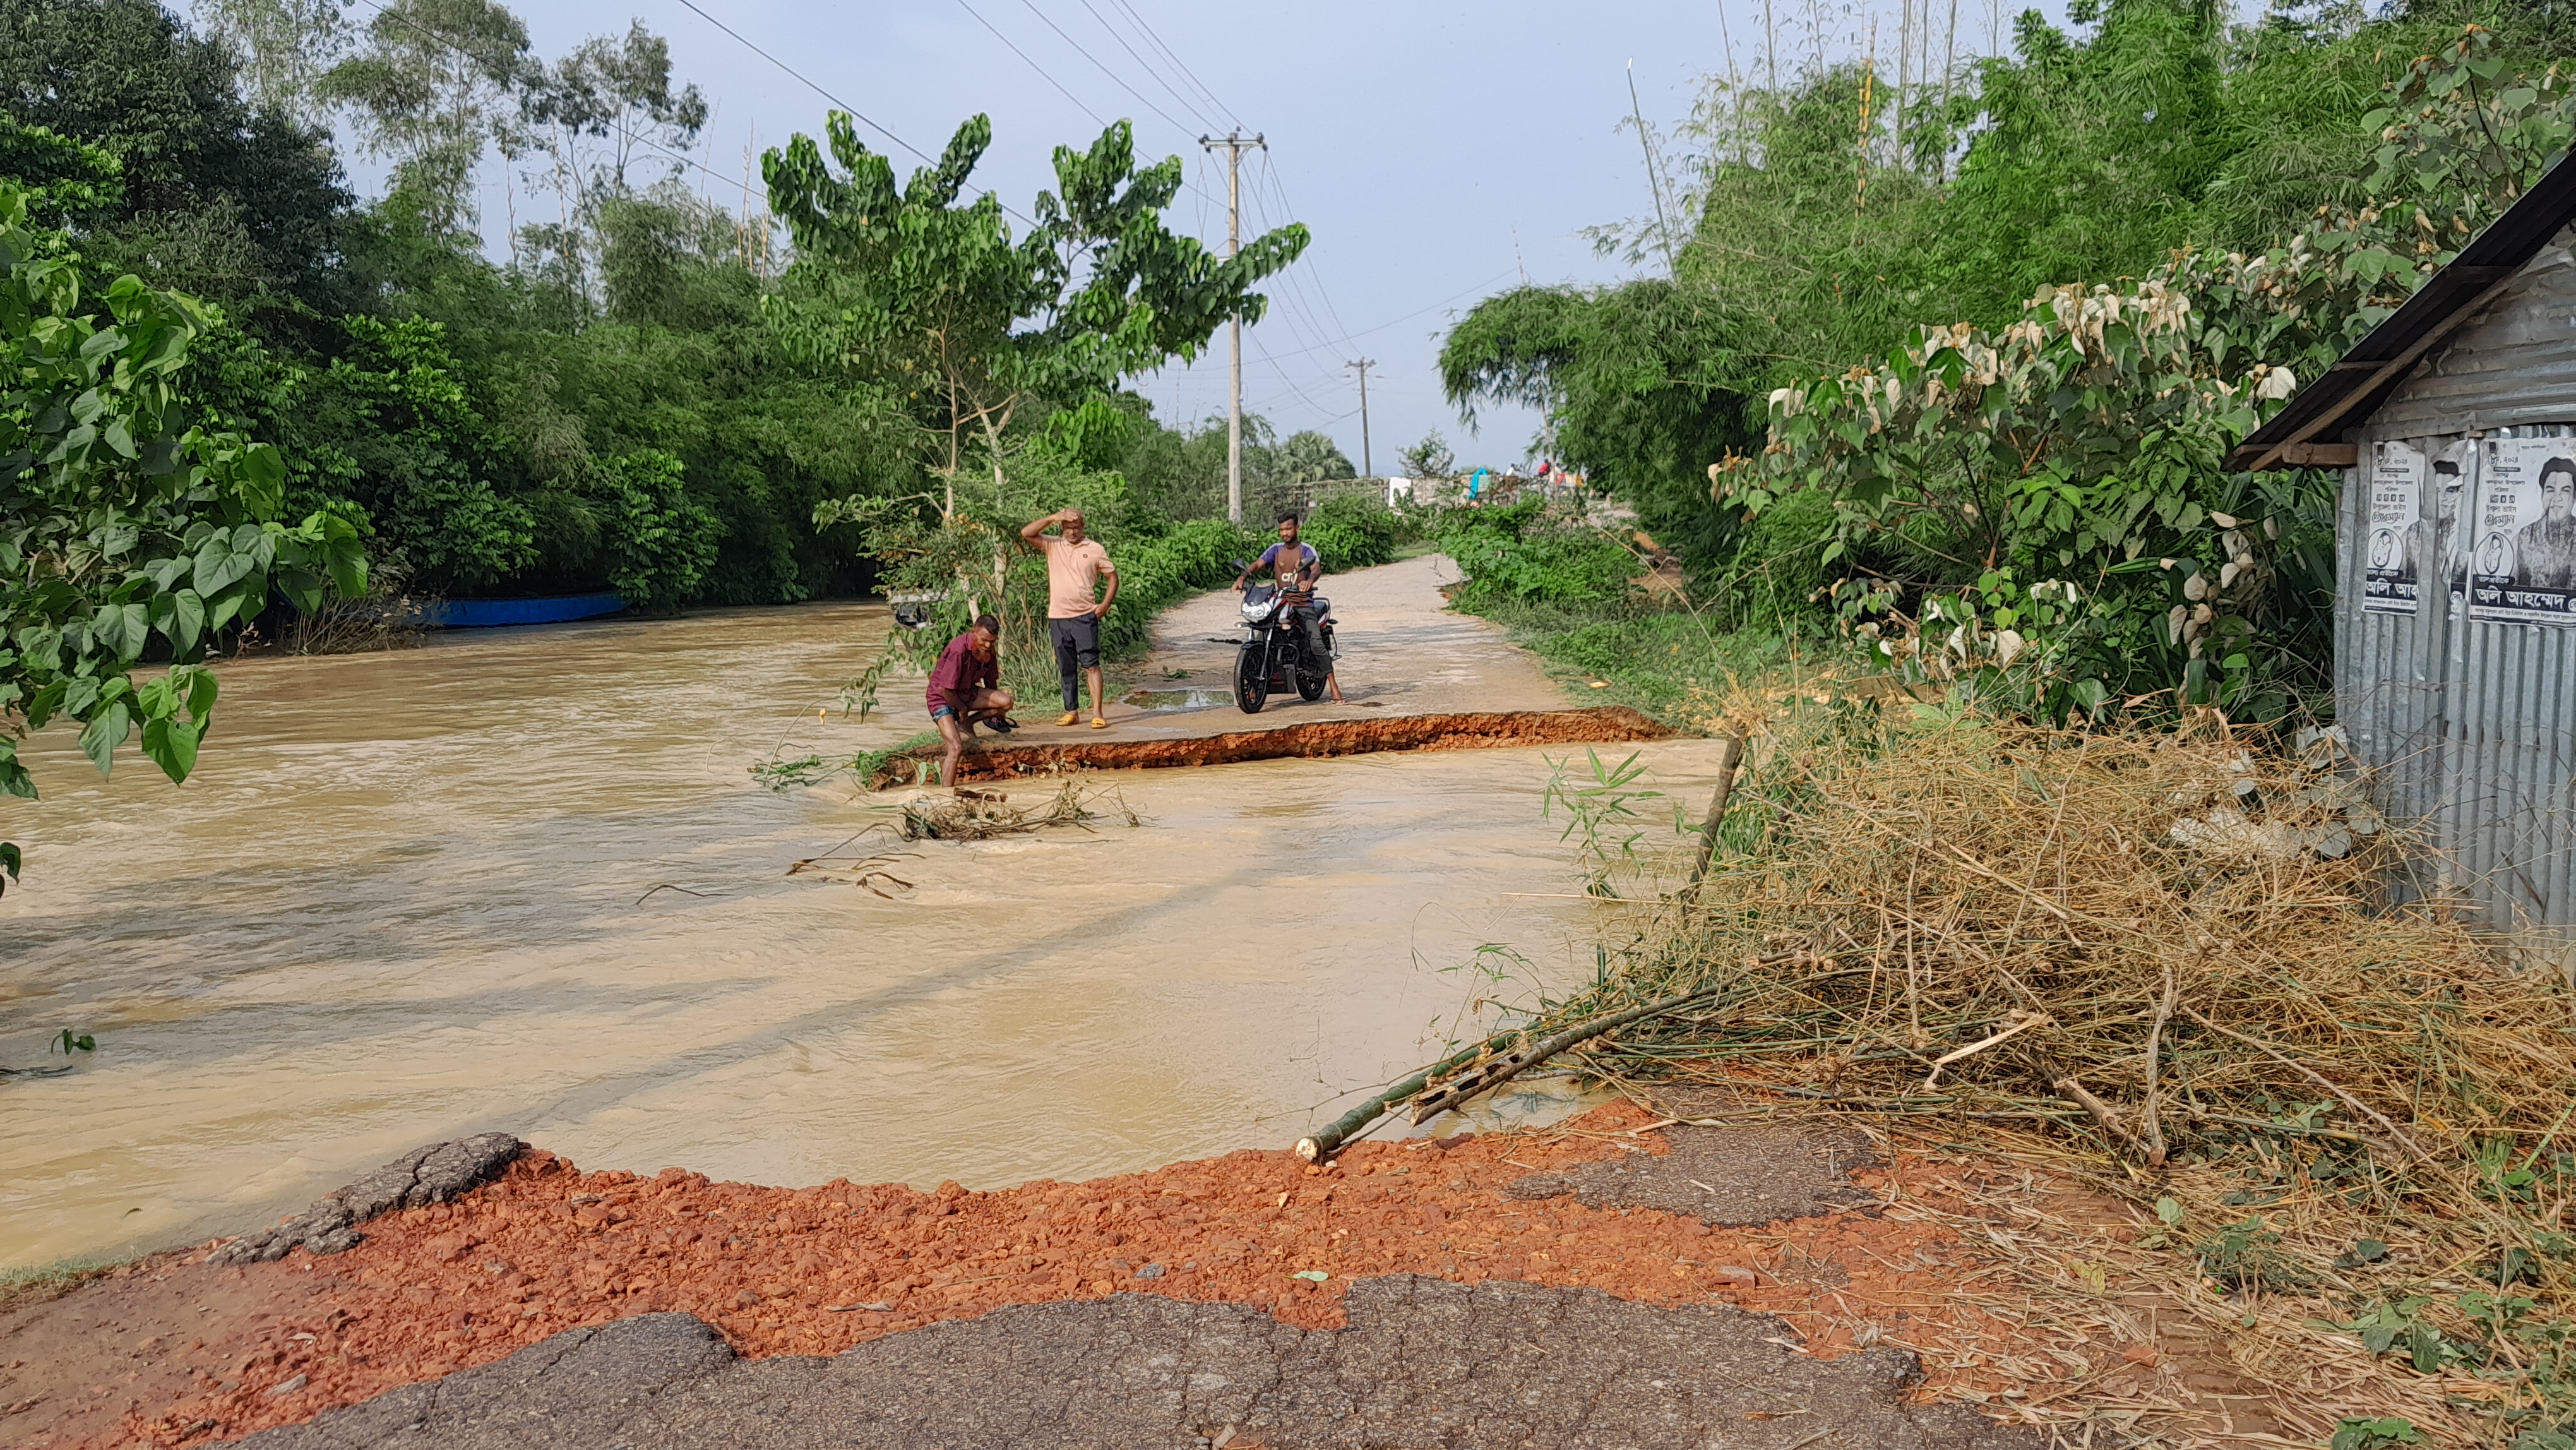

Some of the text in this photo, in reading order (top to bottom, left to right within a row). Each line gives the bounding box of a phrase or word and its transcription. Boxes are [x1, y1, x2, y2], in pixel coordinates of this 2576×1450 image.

[2366, 578, 2392, 596] অলি
[2476, 585, 2503, 604] অলি
[2505, 590, 2567, 609] আহম্মেদ
